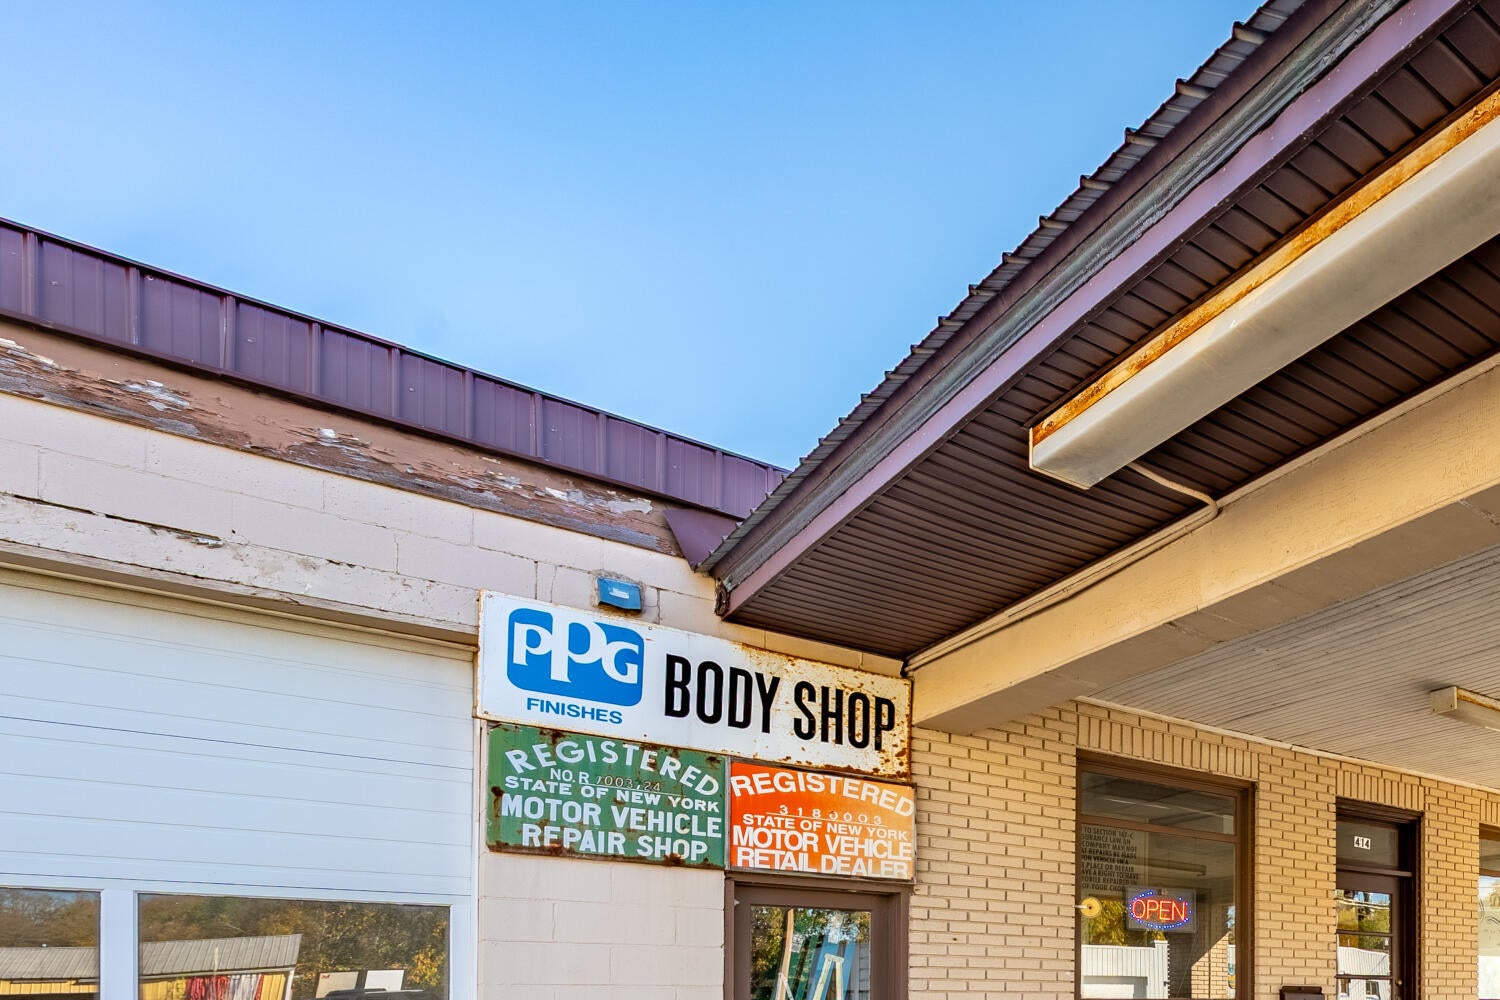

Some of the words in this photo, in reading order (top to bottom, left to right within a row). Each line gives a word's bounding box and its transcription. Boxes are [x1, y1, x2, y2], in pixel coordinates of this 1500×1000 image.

[512, 611, 639, 685] PPG
[526, 697, 623, 725] FINISHES
[664, 653, 781, 734] BODY
[793, 680, 896, 751] SHOP
[504, 740, 720, 796] REGISTERED
[550, 767, 576, 784] NO.
[578, 771, 590, 785] R
[504, 775, 573, 796] STATE
[580, 785, 609, 799] OF
[616, 789, 662, 806] NEW
[668, 796, 720, 813] YORK
[730, 771, 915, 817] REGISTERED
[501, 793, 602, 826] MOTOR
[611, 805, 722, 838] VEHICLE
[742, 813, 796, 830] STATE
[799, 819, 823, 832] OF
[826, 822, 863, 836] NEW
[866, 827, 909, 841] YORK
[522, 823, 626, 855] REPAIR
[636, 835, 708, 861] SHOP
[732, 824, 819, 853] MOTOR
[825, 834, 913, 861] VEHICLE
[1355, 837, 1370, 849] 414
[737, 846, 818, 873] RETAIL
[821, 854, 909, 880] DEALER
[1131, 898, 1187, 922] OPEN
